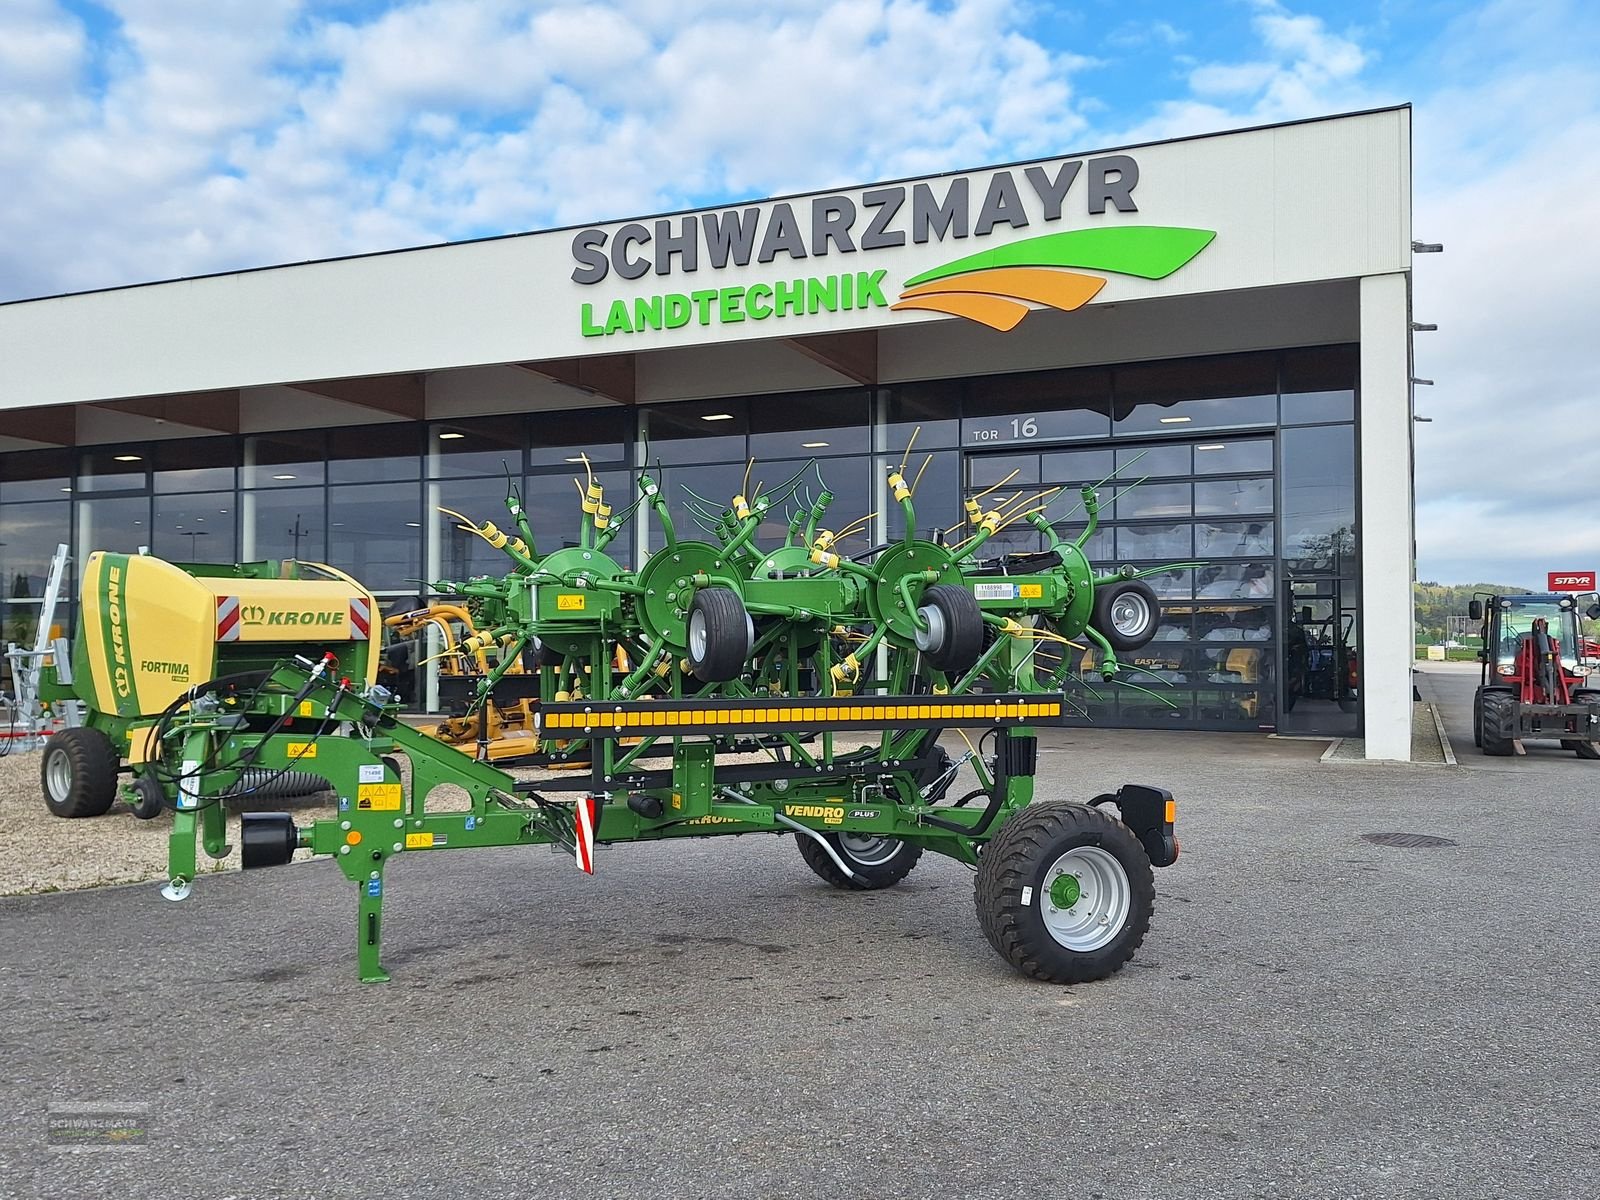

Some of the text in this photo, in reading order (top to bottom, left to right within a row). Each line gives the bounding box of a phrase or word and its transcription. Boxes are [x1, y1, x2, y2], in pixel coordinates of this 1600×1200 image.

[571, 155, 1139, 284] SCHWARZMAYR
[581, 269, 887, 337] LANDTECHNIK
[973, 417, 1038, 440] TOR 16
[109, 566, 125, 664] KRONE
[267, 611, 345, 626] KRONE
[141, 660, 190, 675] FORTIMA
[785, 805, 844, 818] VENDRO
